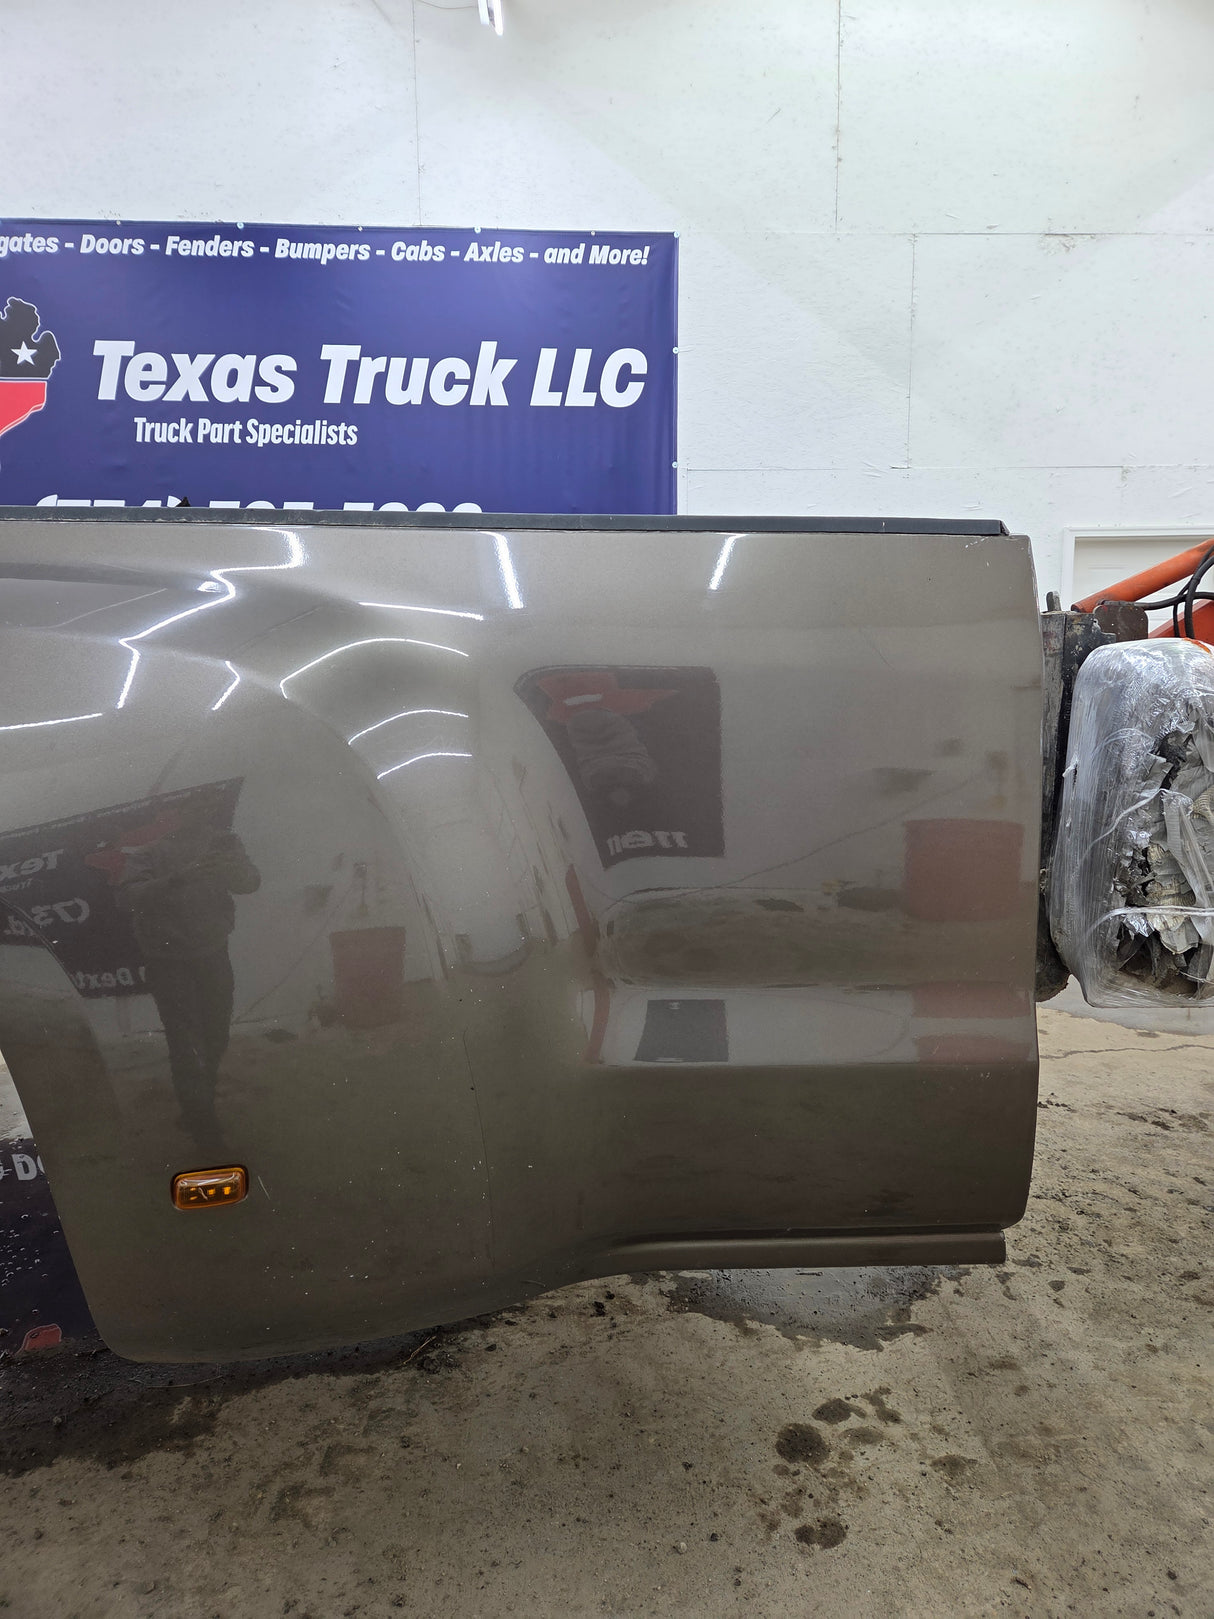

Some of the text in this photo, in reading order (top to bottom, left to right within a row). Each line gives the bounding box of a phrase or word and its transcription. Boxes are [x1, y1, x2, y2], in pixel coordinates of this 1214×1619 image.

[79, 234, 145, 255] Doors
[165, 235, 254, 258] Fenders
[274, 238, 371, 265] Bumpers
[390, 240, 446, 262] Cabs
[464, 241, 525, 263] Axles
[543, 242, 586, 265] and
[588, 245, 651, 266] More!
[92, 339, 648, 408] Texas Truck LLC
[133, 417, 359, 447] Truck Part Specialists
[11, 1153, 45, 1181] D
